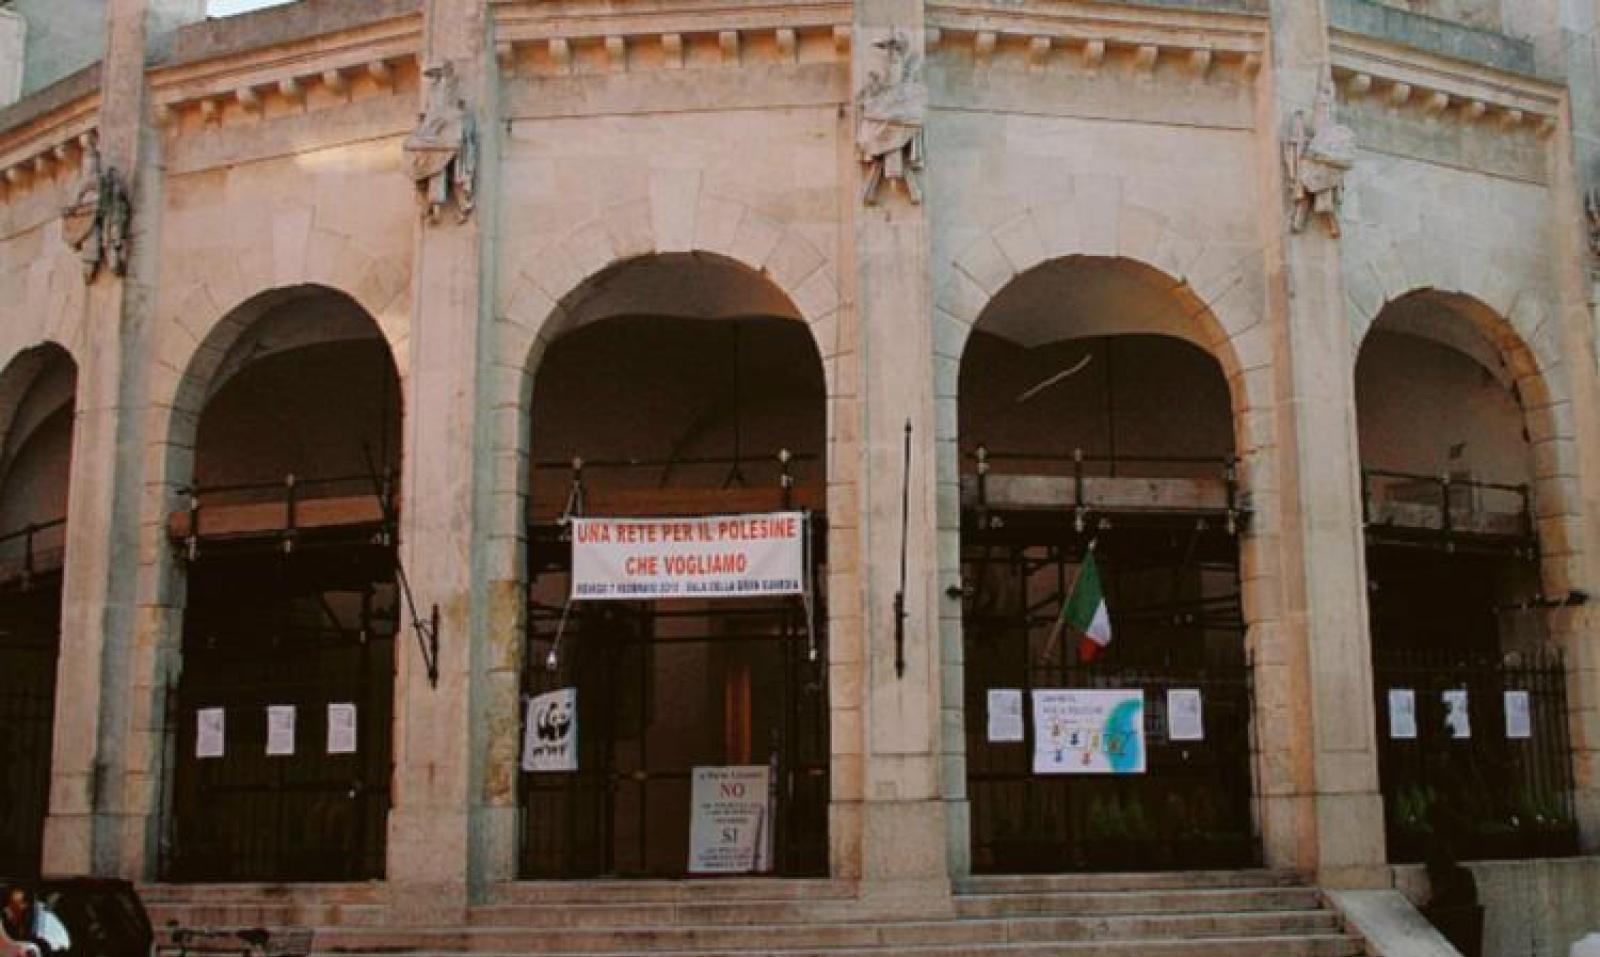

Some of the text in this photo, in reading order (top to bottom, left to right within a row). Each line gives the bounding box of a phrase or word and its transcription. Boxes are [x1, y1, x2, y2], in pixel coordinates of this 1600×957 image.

[577, 518, 796, 543] UNA RETE PER IL POLESINE
[625, 553, 747, 576] CHE VOGLIAMO
[720, 783, 745, 798] NO
